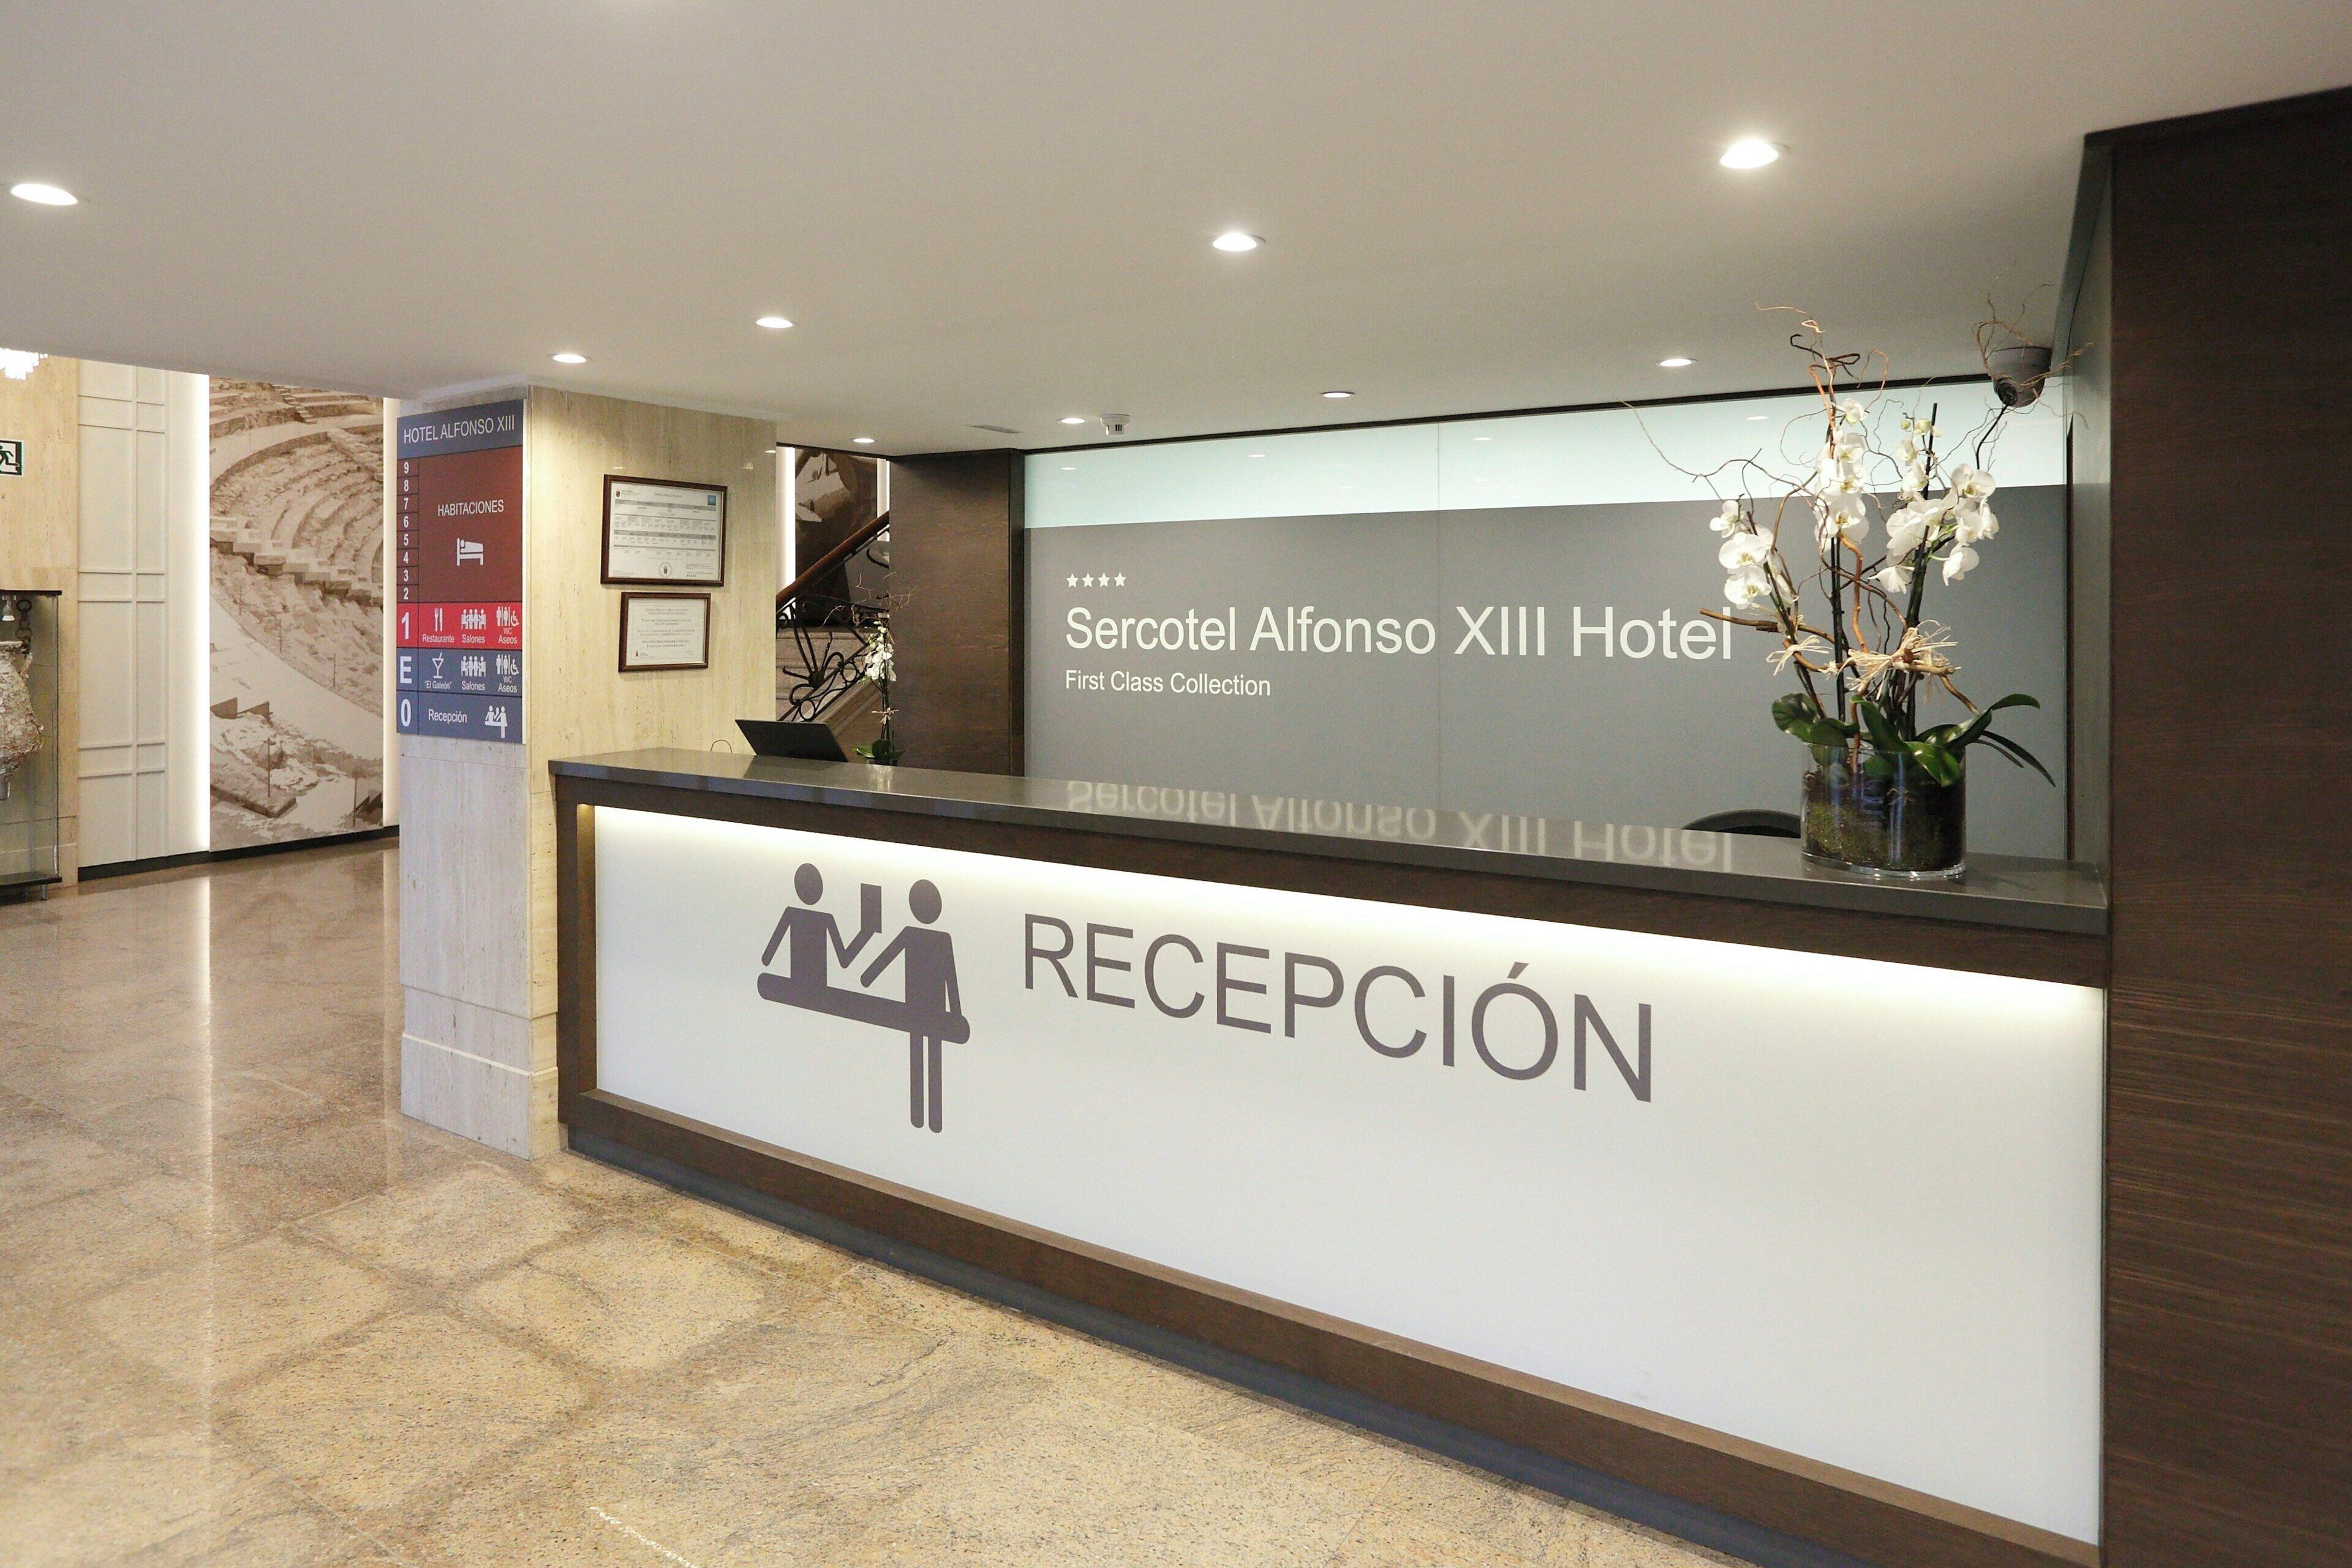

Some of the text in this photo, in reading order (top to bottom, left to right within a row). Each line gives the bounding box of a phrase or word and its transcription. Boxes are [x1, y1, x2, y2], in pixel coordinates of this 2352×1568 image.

[404, 414, 514, 443] HOTEL ALFONSO XIII
[404, 462, 409, 474] 9
[404, 480, 409, 492] 8
[404, 497, 409, 510] 7
[438, 499, 504, 516] HABITACIONES
[403, 516, 409, 528] 6
[403, 533, 409, 546] 5
[403, 552, 409, 564] 4
[403, 569, 409, 582] 3
[403, 587, 409, 600] 2
[401, 612, 409, 639] 1
[423, 633, 454, 643] Restaurante
[462, 633, 485, 644] Salones
[1066, 605, 1732, 660] Sercotel Alfonso XIII Hotel
[498, 635, 517, 644] Aseos
[400, 656, 412, 684] E
[462, 680, 485, 691] Salones
[498, 683, 517, 693] Aseos
[1066, 669, 1271, 696] First Class Collection
[428, 709, 467, 723] Recepción
[1024, 913, 1651, 1102] RECEPCIÓN
